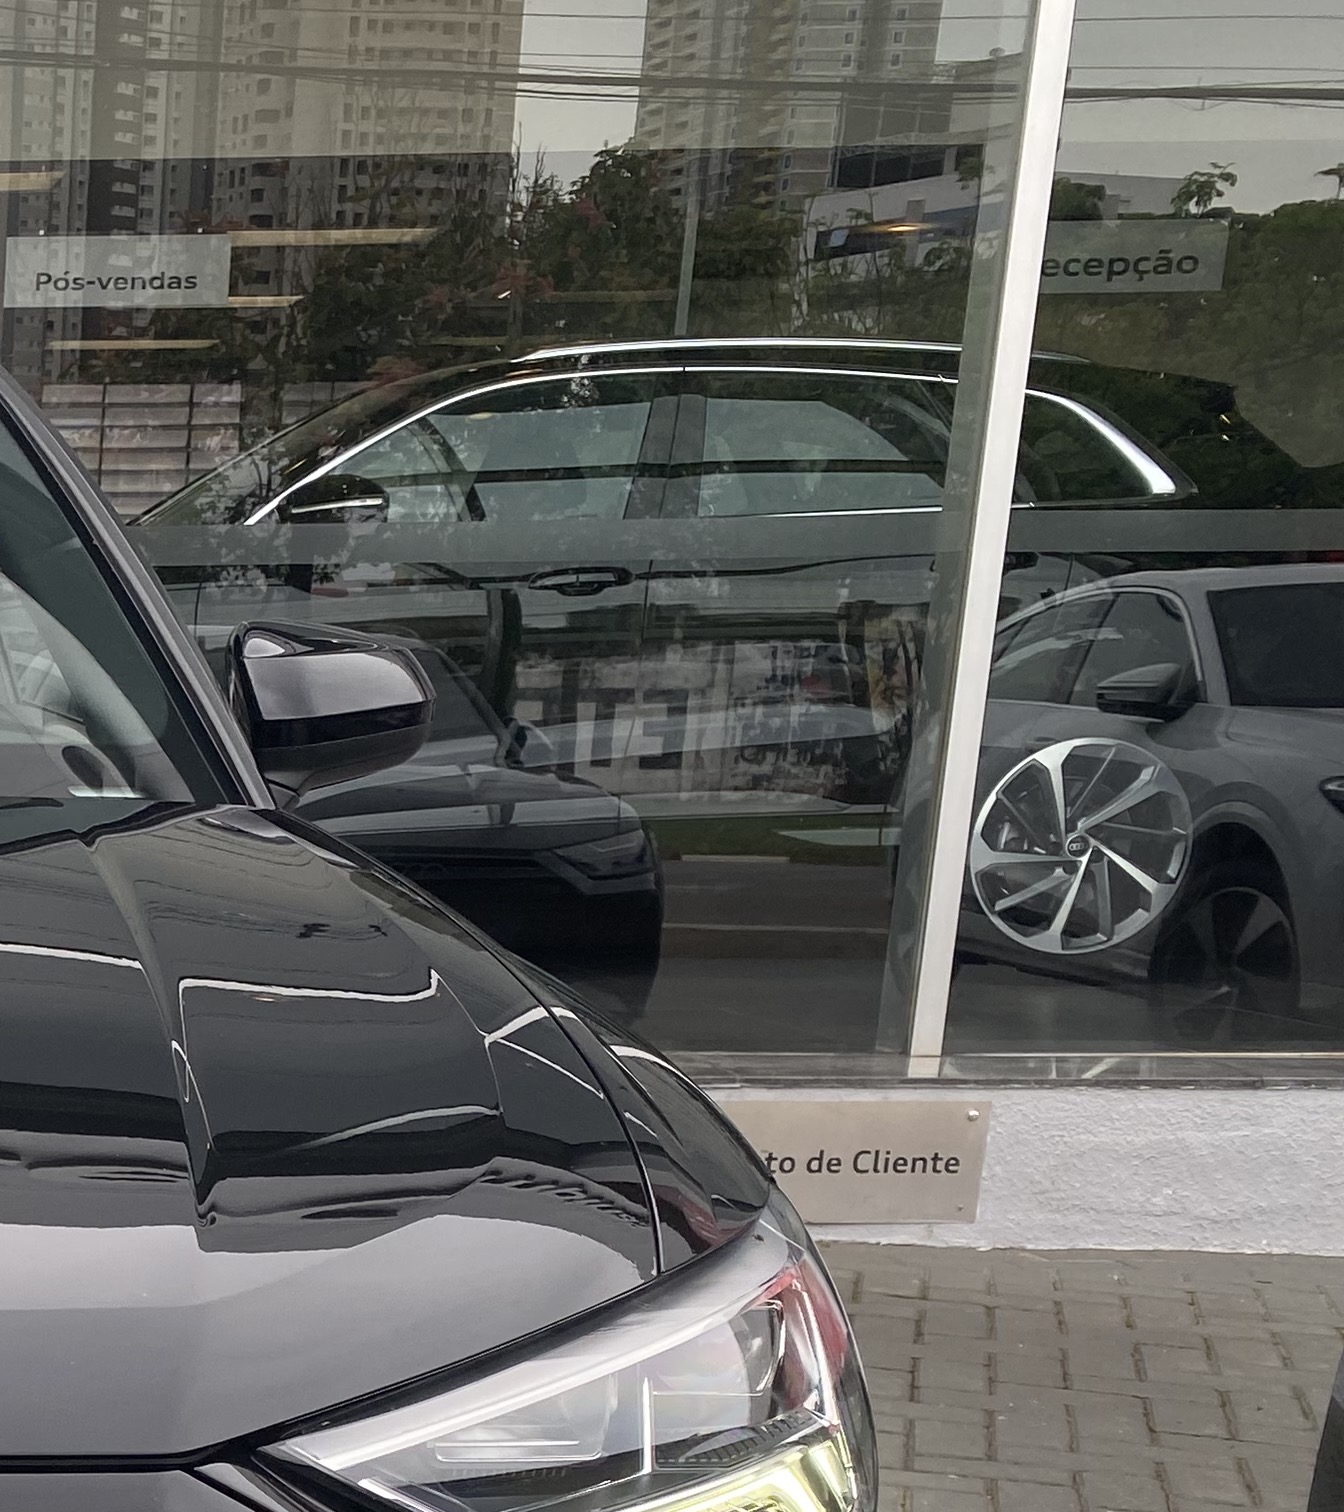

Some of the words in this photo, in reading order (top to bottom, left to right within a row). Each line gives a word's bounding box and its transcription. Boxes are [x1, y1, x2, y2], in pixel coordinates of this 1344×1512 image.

[1040, 248, 1200, 282] ecepção
[34, 270, 199, 292] Pós-vendas
[764, 1151, 797, 1175] to
[806, 1149, 843, 1174] de
[852, 1149, 961, 1175] Cliente
